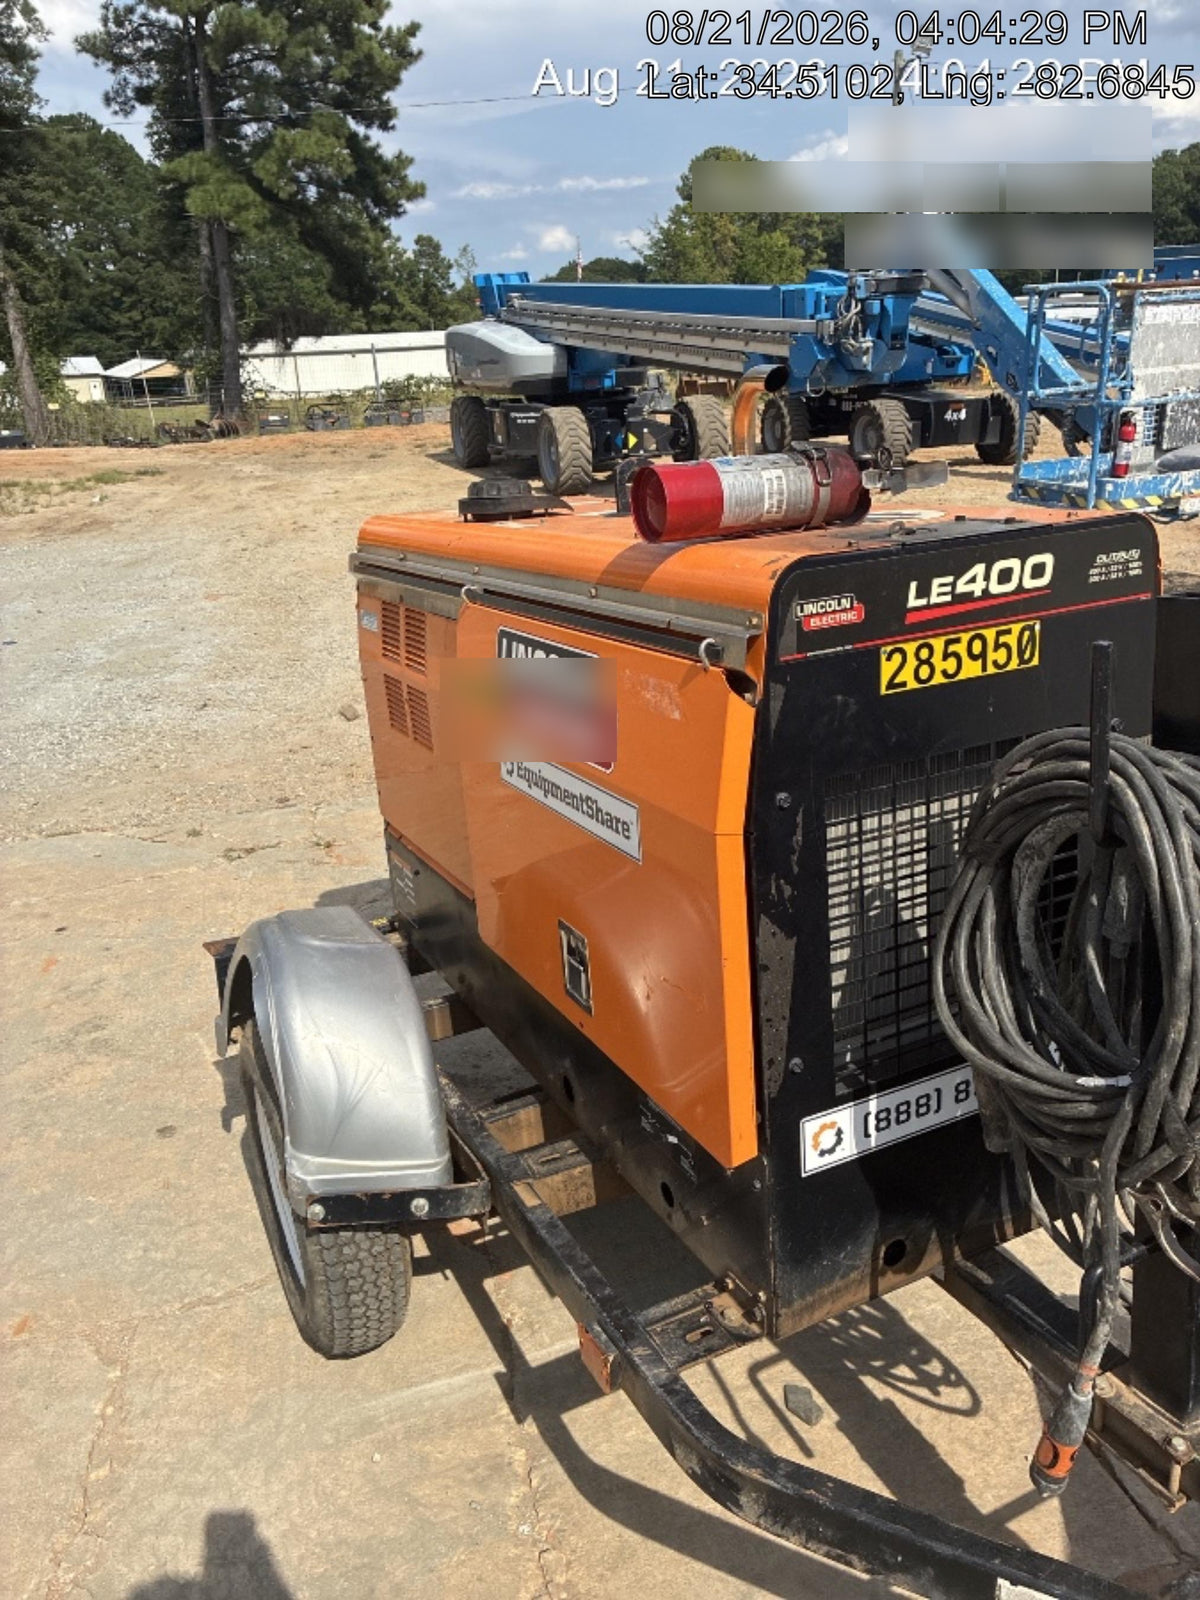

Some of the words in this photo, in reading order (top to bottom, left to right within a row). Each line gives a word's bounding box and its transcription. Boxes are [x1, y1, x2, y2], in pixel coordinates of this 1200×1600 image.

[796, 596, 851, 616] LINCOLN
[906, 552, 1056, 609] LE400
[810, 610, 858, 627] ELECTRIC
[884, 622, 1038, 692] 285950
[516, 762, 631, 841] EquipmentShare
[863, 1087, 943, 1138] (888)
